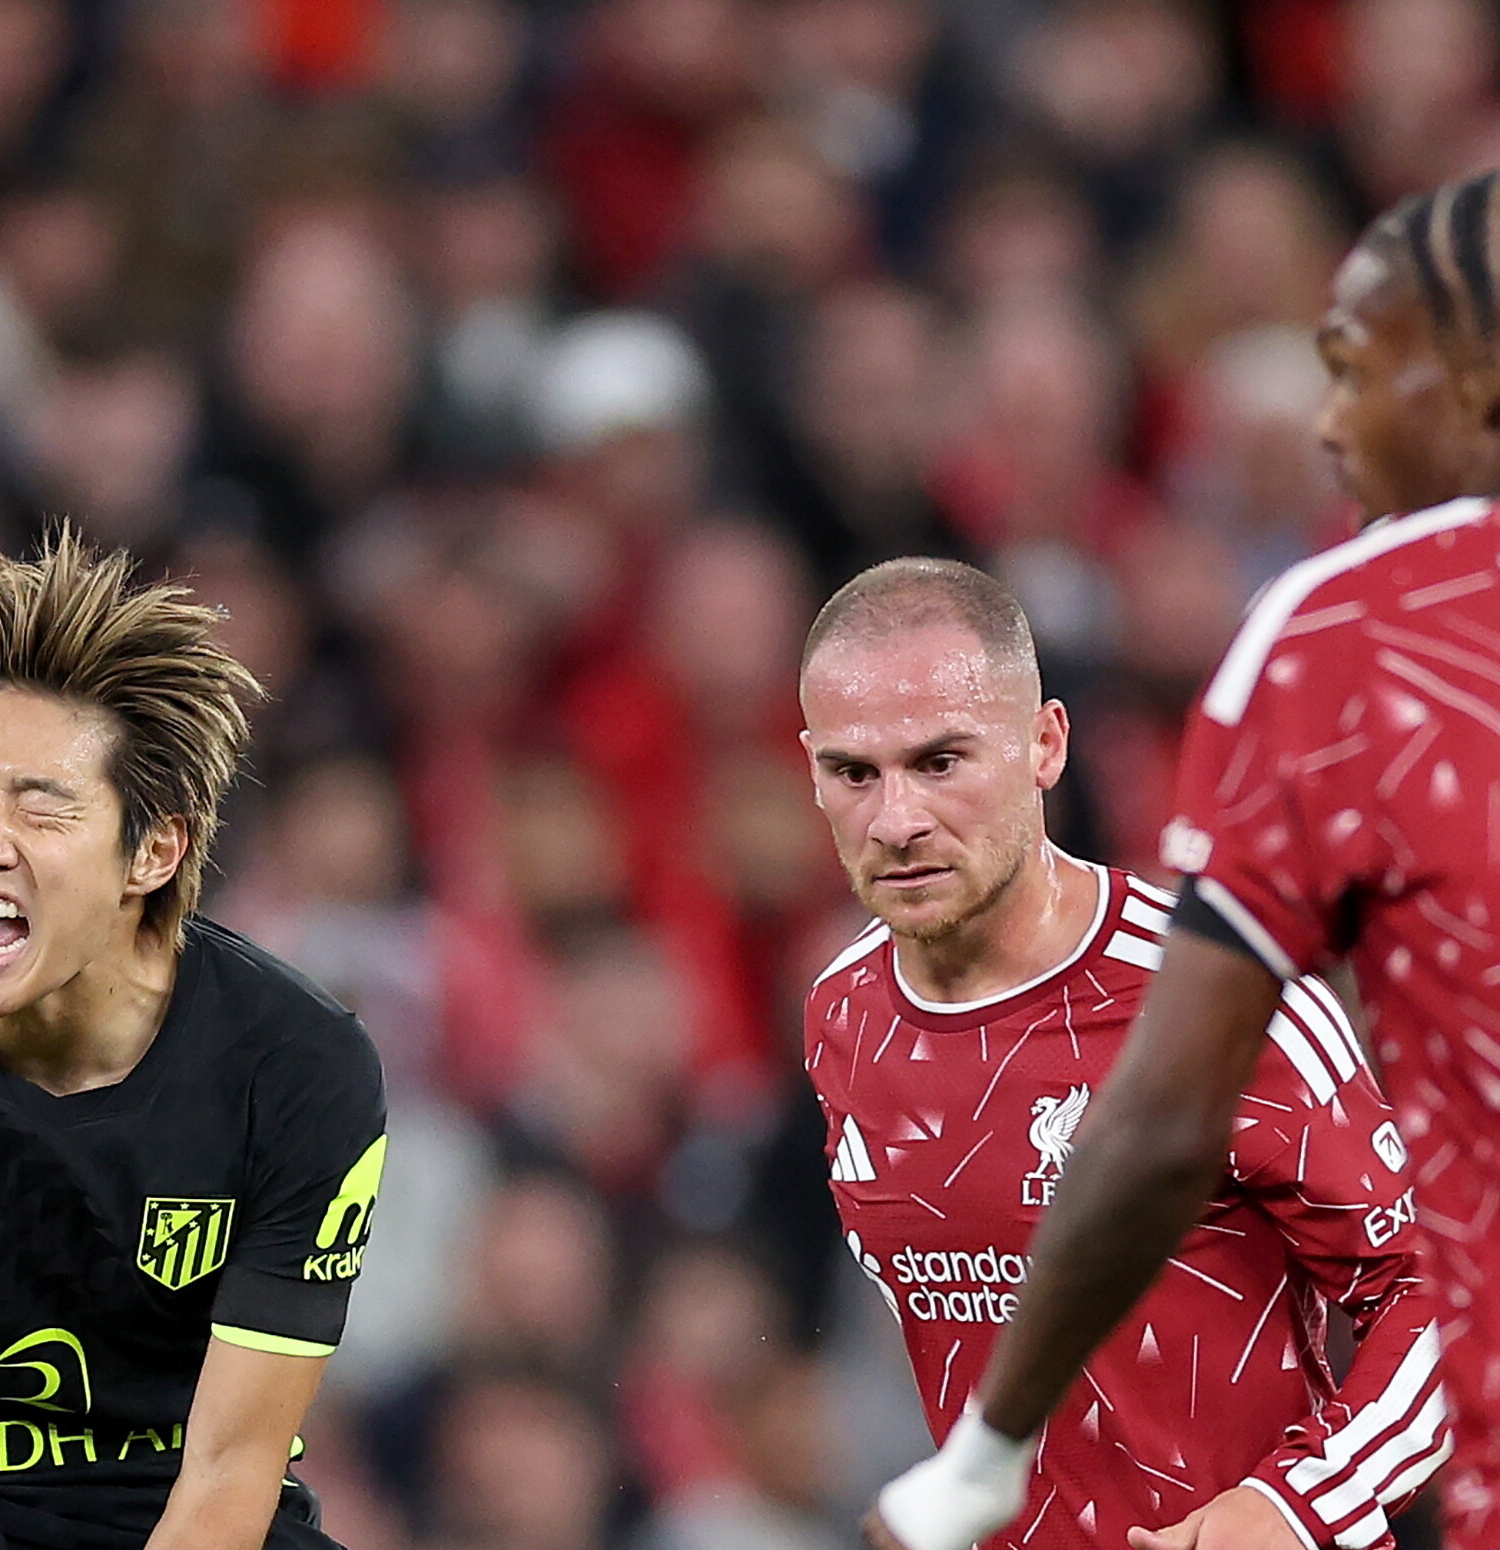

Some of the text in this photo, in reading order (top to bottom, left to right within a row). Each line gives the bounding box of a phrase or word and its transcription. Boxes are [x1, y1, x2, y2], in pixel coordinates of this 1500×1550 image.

[892, 1245, 1034, 1284] standa
[908, 1285, 1020, 1324] charte
[118, 1423, 182, 1461] AI
